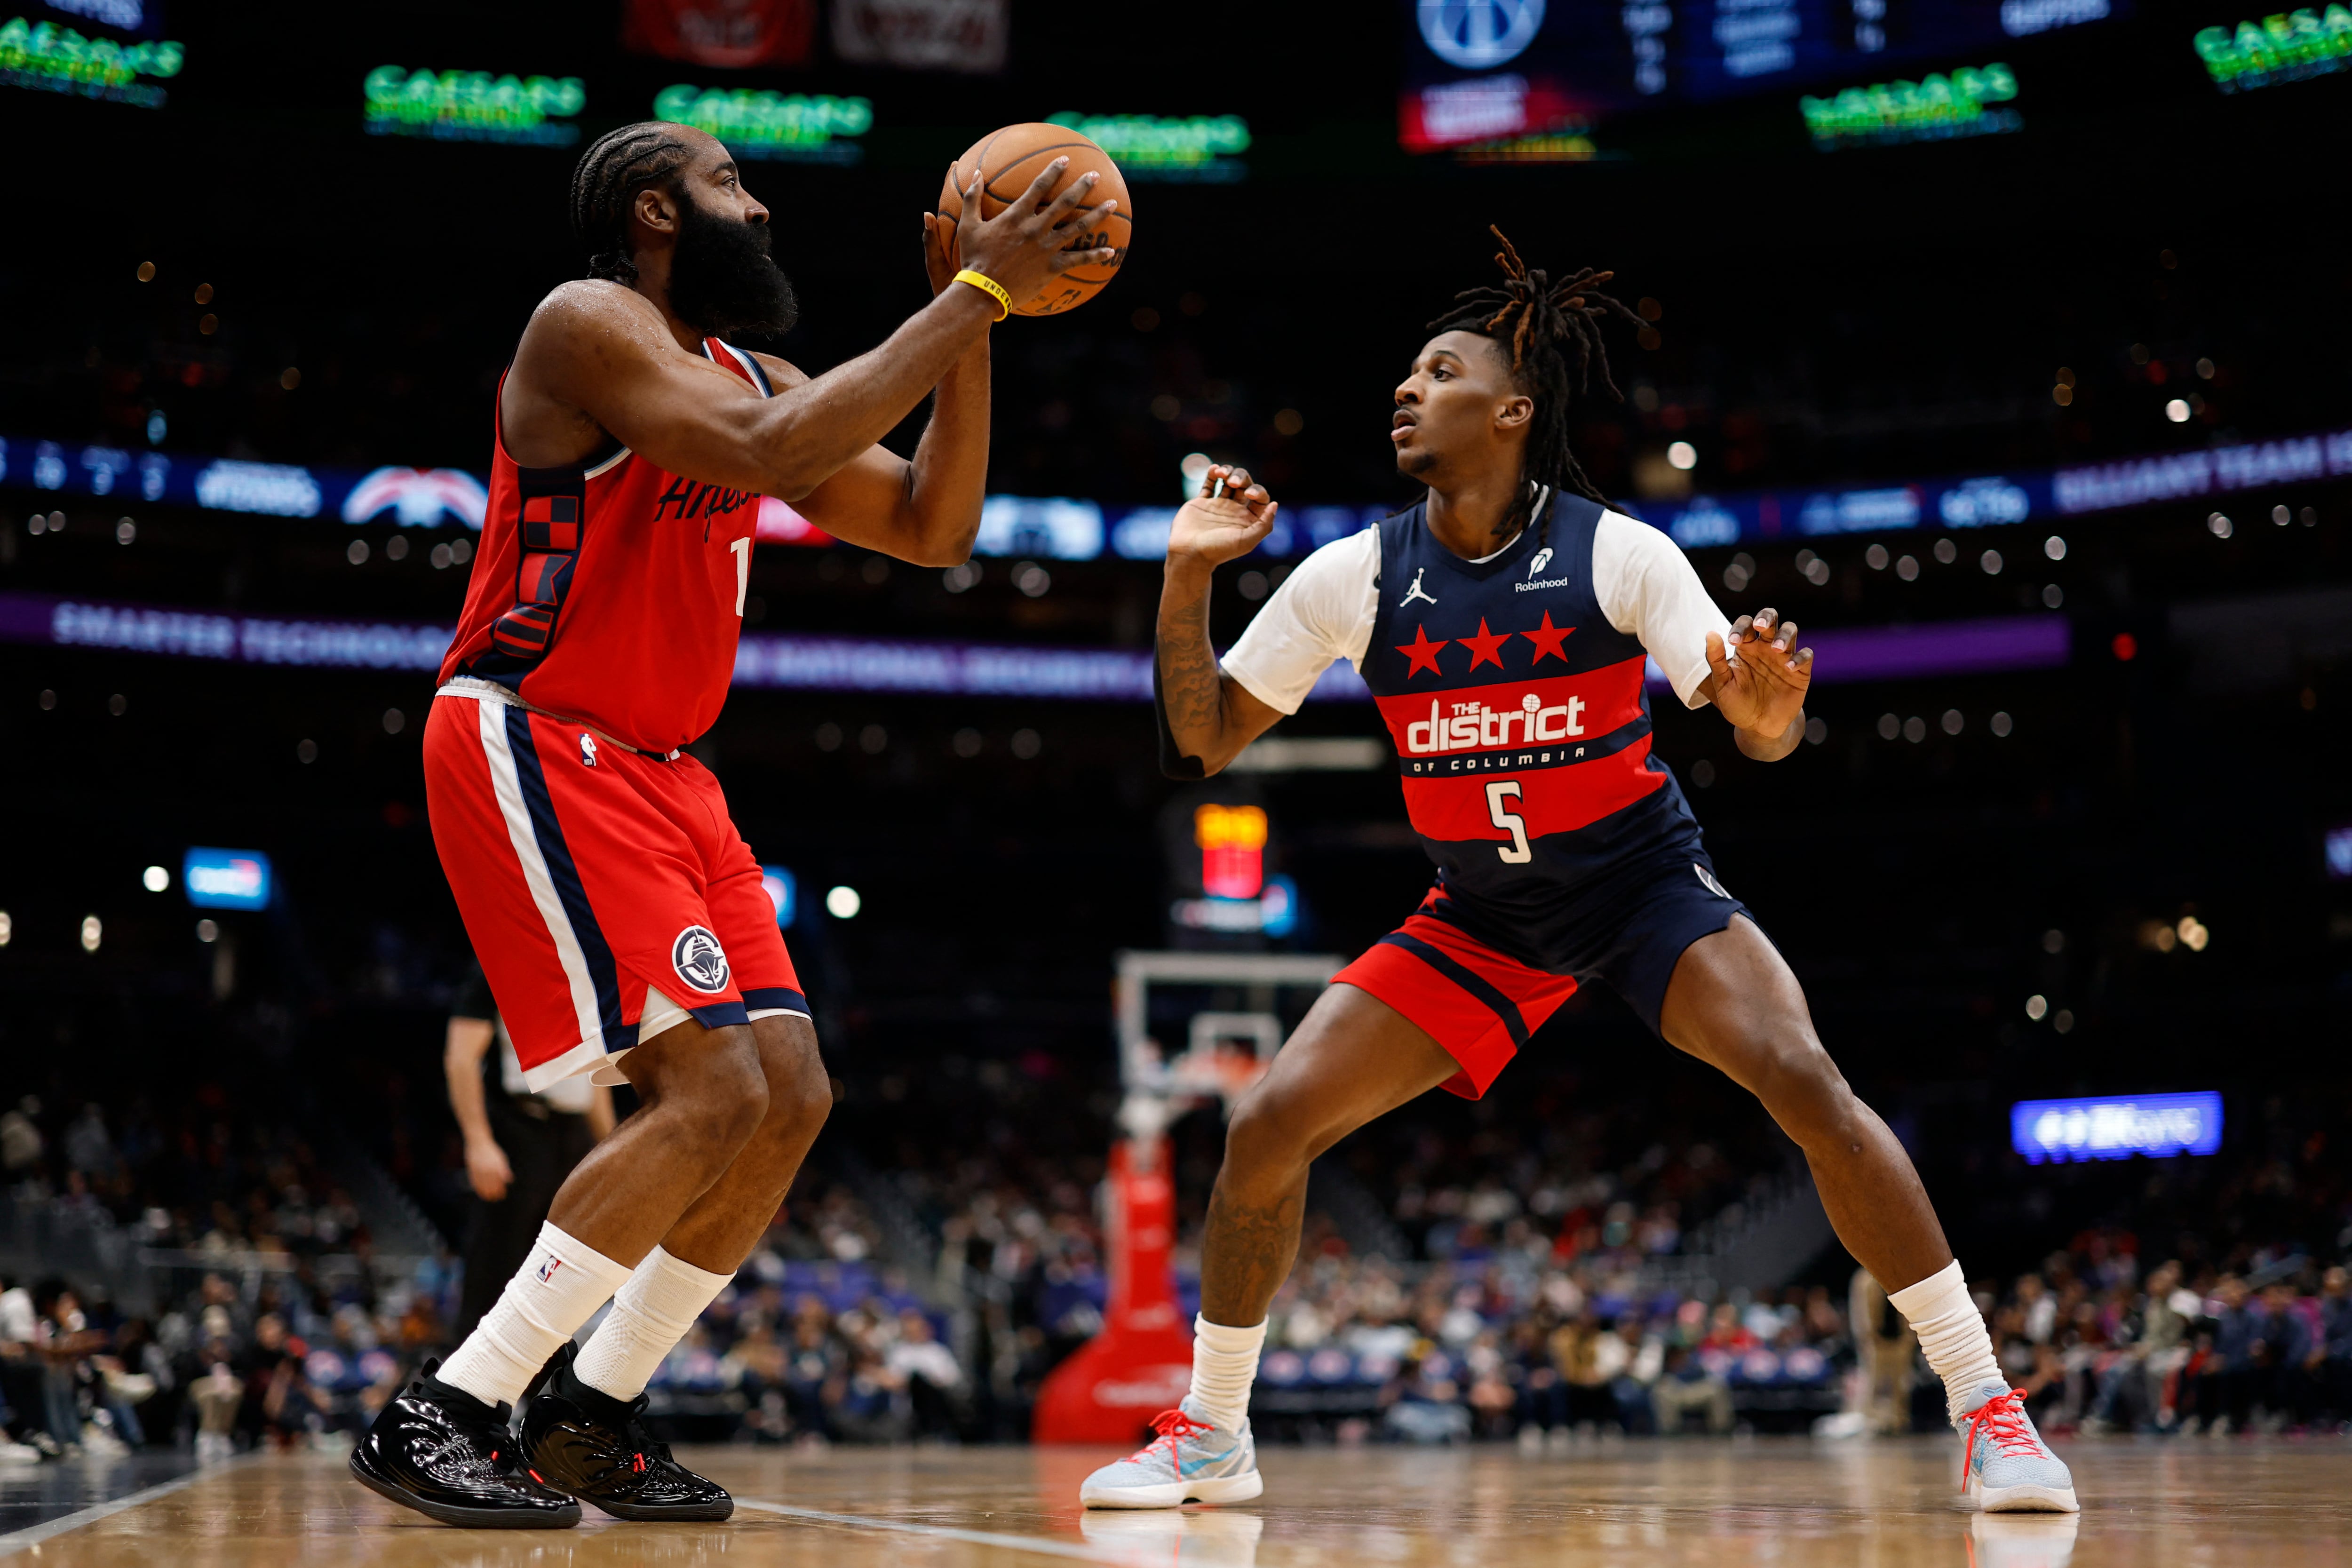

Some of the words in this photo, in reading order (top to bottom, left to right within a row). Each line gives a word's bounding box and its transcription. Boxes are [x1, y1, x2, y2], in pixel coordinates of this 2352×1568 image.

[730, 536, 751, 617] 1
[1515, 576, 1568, 593] Robinhood
[1407, 693, 1585, 753] district
[1451, 701, 1481, 716] THE
[1414, 762, 1434, 772] OF
[1451, 747, 1585, 770] COLUMBIA
[1485, 780, 1532, 864] 5
